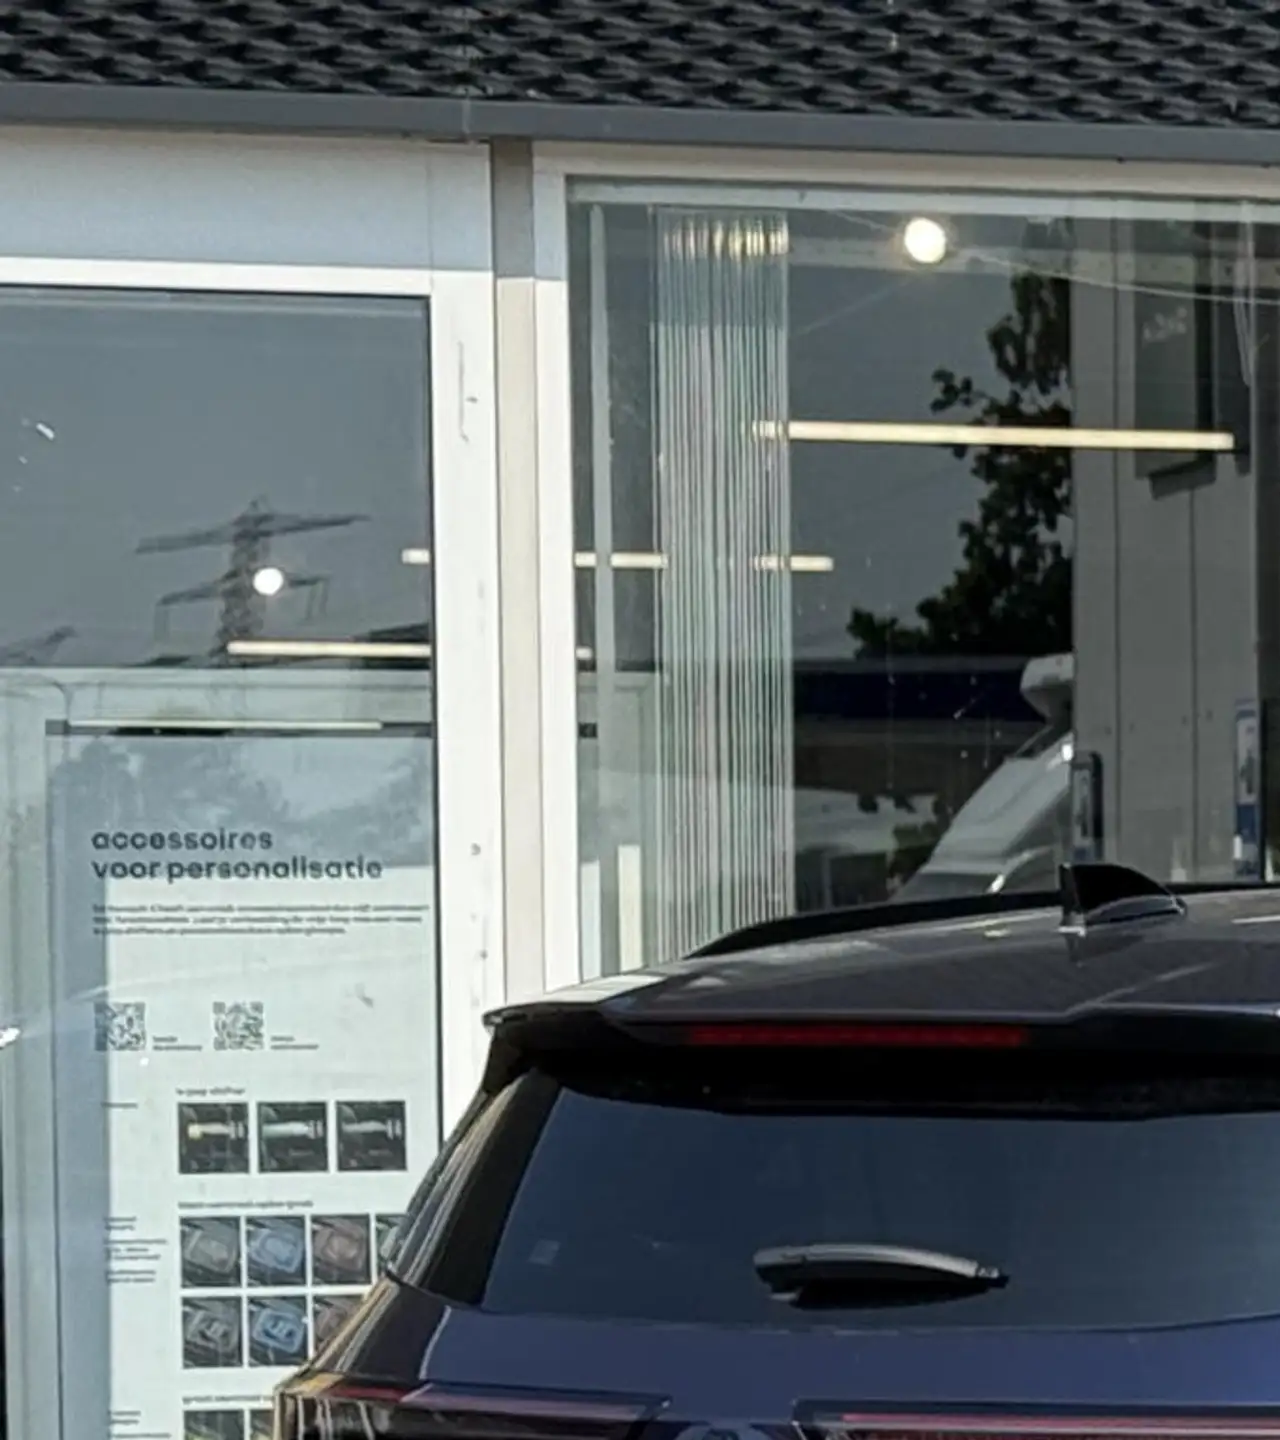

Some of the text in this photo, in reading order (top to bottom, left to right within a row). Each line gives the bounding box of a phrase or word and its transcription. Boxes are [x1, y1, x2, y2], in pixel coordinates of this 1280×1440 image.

[91, 827, 274, 851] accessoires
[91, 854, 383, 884] voor personalisatie
